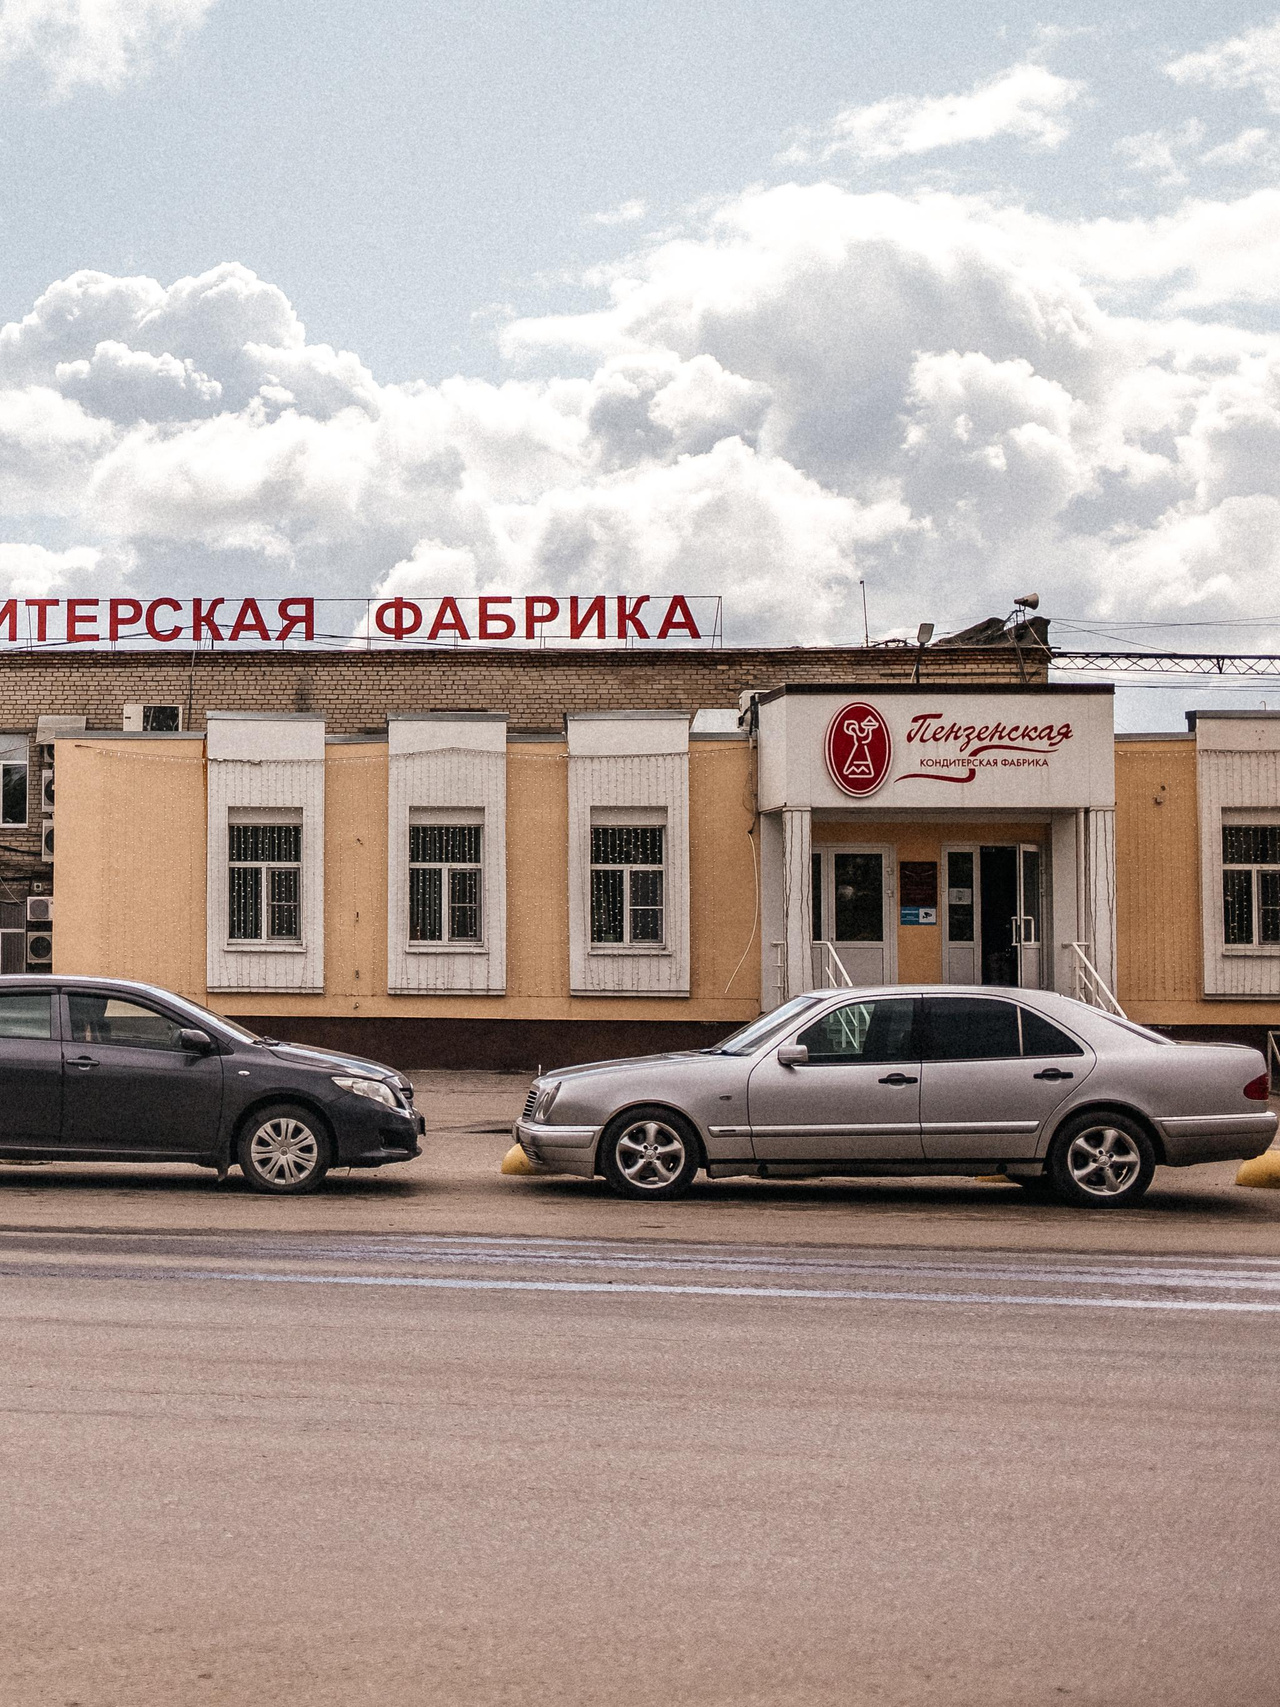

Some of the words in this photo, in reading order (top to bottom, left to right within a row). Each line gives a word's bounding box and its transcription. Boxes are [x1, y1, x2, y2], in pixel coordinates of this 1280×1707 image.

[375, 596, 700, 641] ФАБРИКА
[907, 713, 1073, 752] Пензенская
[920, 758, 998, 768] КОНДИТЕРСКАЯ
[1001, 758, 1049, 767] ФАБРИКА
